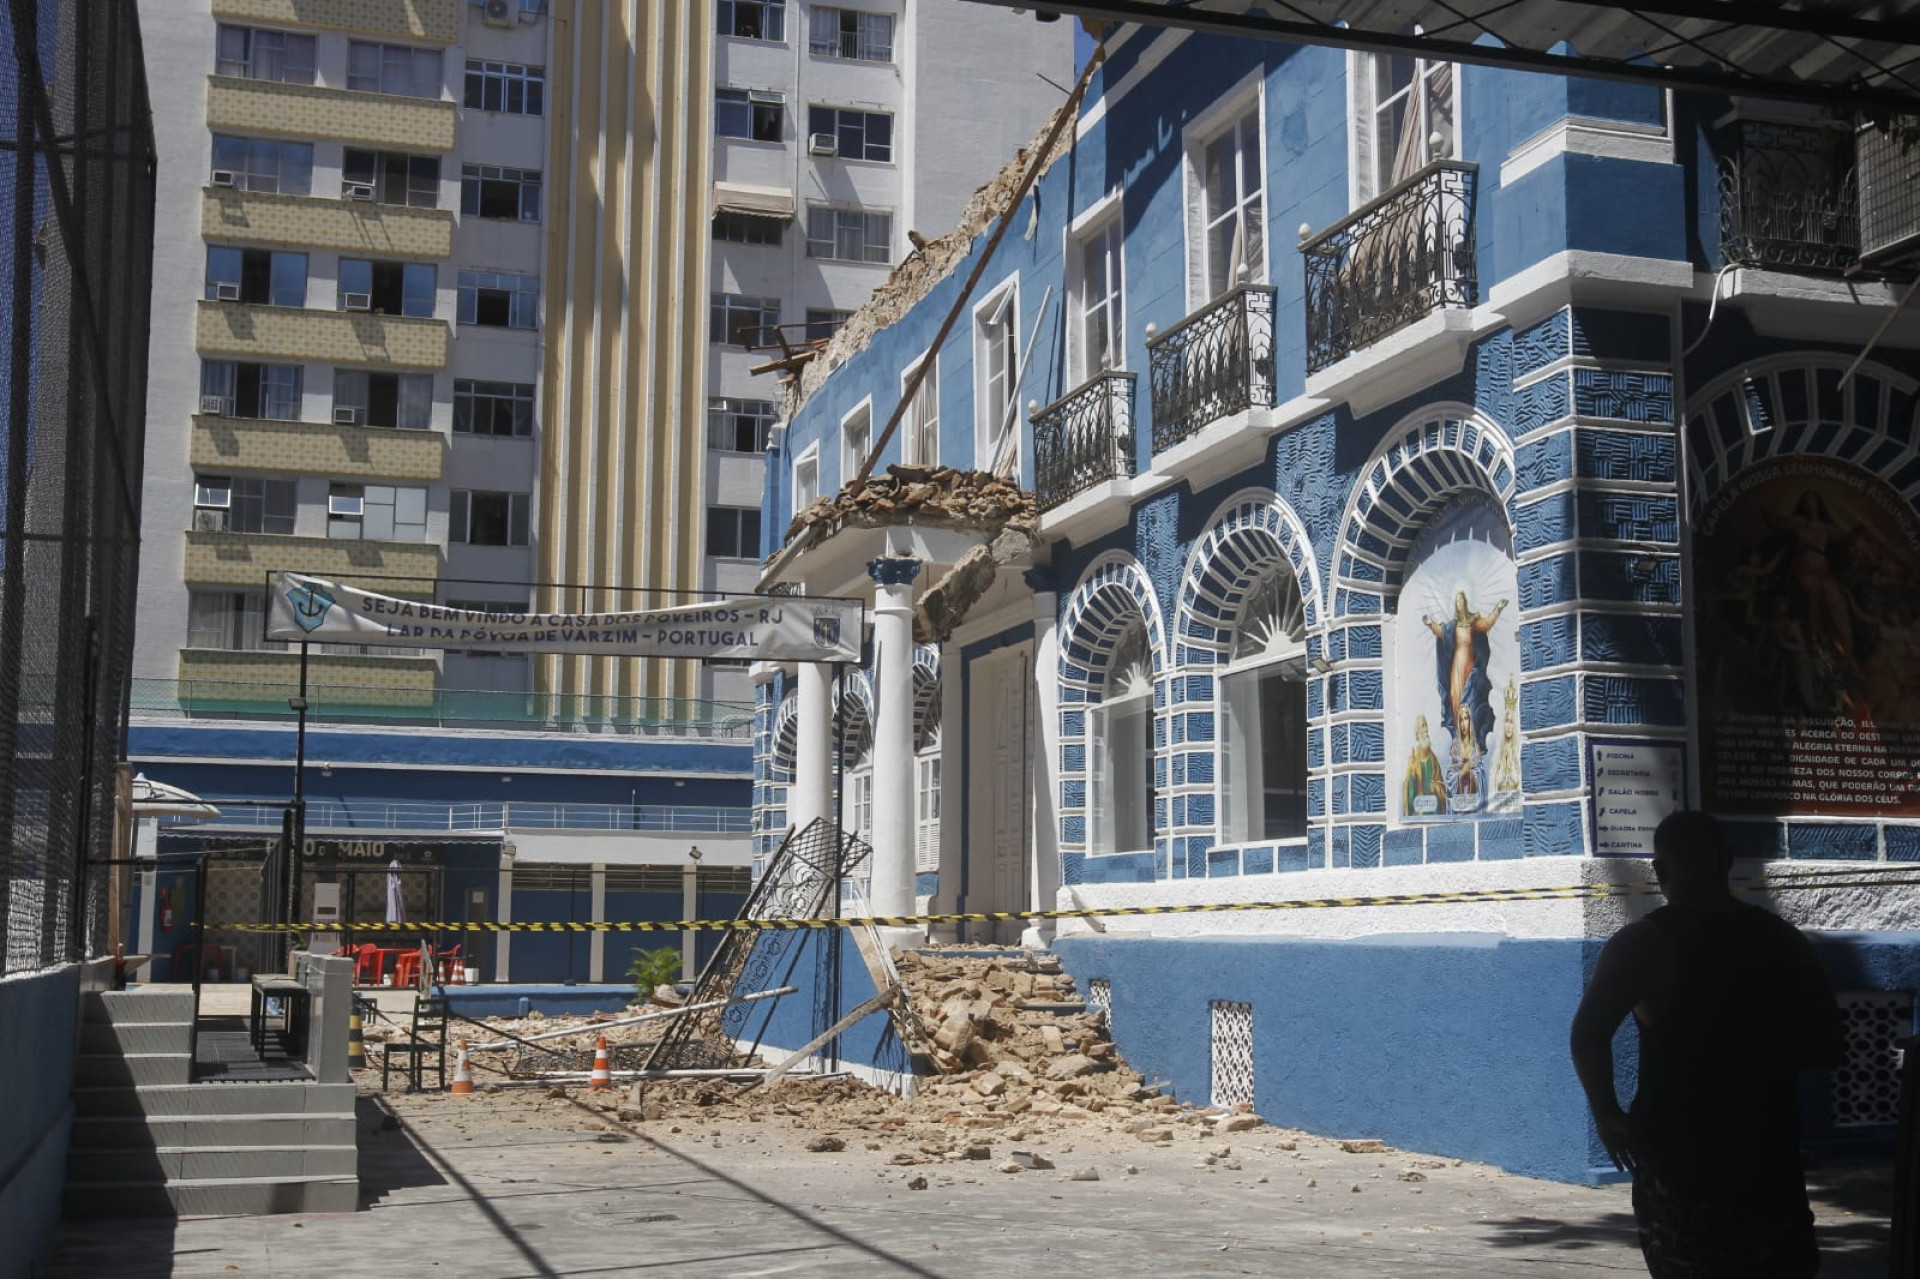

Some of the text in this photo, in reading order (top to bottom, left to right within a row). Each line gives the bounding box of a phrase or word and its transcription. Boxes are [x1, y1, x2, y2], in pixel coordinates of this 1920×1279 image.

[1702, 488, 1741, 536] CAPELA
[1740, 466, 1782, 492] NOSSA
[1783, 462, 1846, 483] SENHORA
[363, 597, 413, 616] SEJA
[419, 605, 459, 621] BEM
[465, 611, 525, 625] VINDO
[530, 614, 543, 626] A
[547, 613, 599, 627] CASA
[604, 614, 640, 625] DOS
[643, 609, 739, 625] POVEIROS
[759, 609, 783, 625] RJ
[386, 623, 424, 637] LAR
[430, 628, 455, 639] DA
[534, 630, 556, 642] DE
[561, 629, 637, 644] VARZIM
[658, 630, 758, 646] PORTUGAL
[1800, 729, 1837, 739] ACERCA
[1841, 731, 1854, 739] DO
[1792, 742, 1833, 751] ALEGRIA
[1834, 744, 1872, 753] ETERNA
[1874, 745, 1887, 753] NA
[1788, 755, 1840, 765] DIGNIDADE
[1844, 756, 1857, 765] DE
[1861, 757, 1886, 766] CADA
[1816, 768, 1835, 776] DOS
[1838, 769, 1875, 778] NOSSOS
[1878, 770, 1914, 780] CORPOS
[1818, 780, 1838, 791] QUE
[1841, 780, 1886, 791] PODERÃO
[1890, 783, 1905, 792] UM
[1802, 793, 1817, 801] NA
[1818, 792, 1853, 802] GLÓRIA
[1854, 794, 1873, 802] DOS
[1875, 793, 1902, 804] CÉUS.
[337, 841, 384, 858] MAIO
